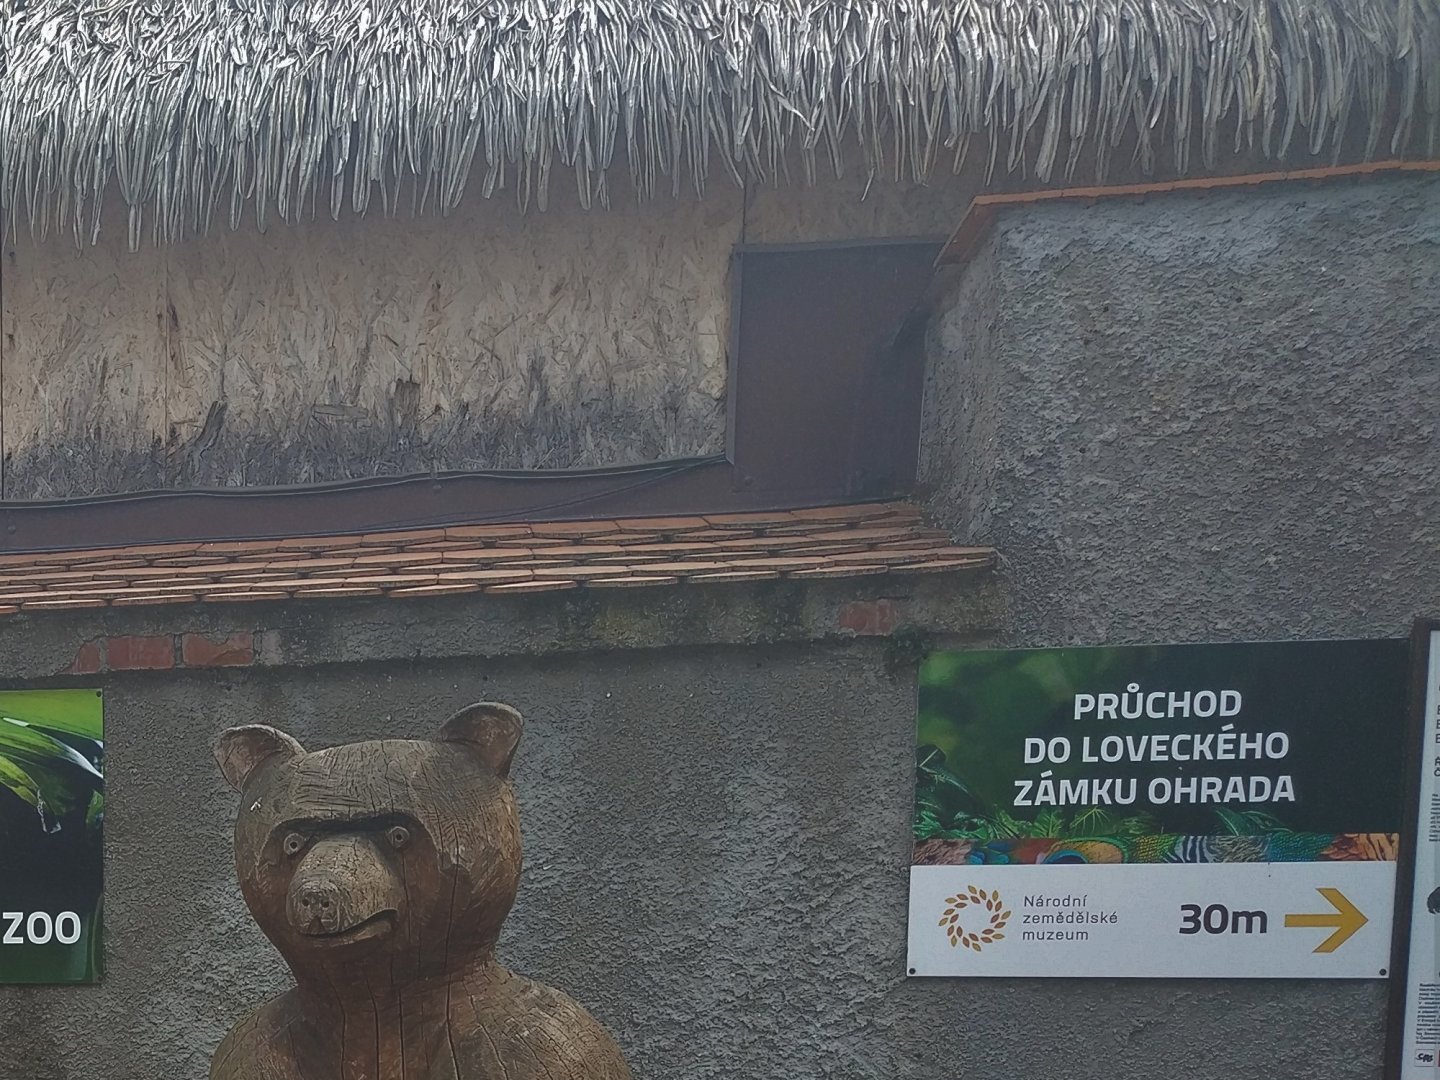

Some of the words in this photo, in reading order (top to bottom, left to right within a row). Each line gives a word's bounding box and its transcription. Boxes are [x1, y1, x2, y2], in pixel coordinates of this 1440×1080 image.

[1073, 682, 1243, 720] PRŮCHOD
[1023, 736, 1071, 764] DO
[1081, 723, 1290, 763] LOVECKÉHO
[1013, 770, 1138, 807] ZÁMKU
[1148, 775, 1296, 805] OHRADA
[1023, 894, 1087, 907] Národní
[2, 911, 82, 944] ZOO
[1022, 910, 1118, 924] zemědělské
[1178, 903, 1268, 935] 30m
[1022, 929, 1089, 941] muzeum
